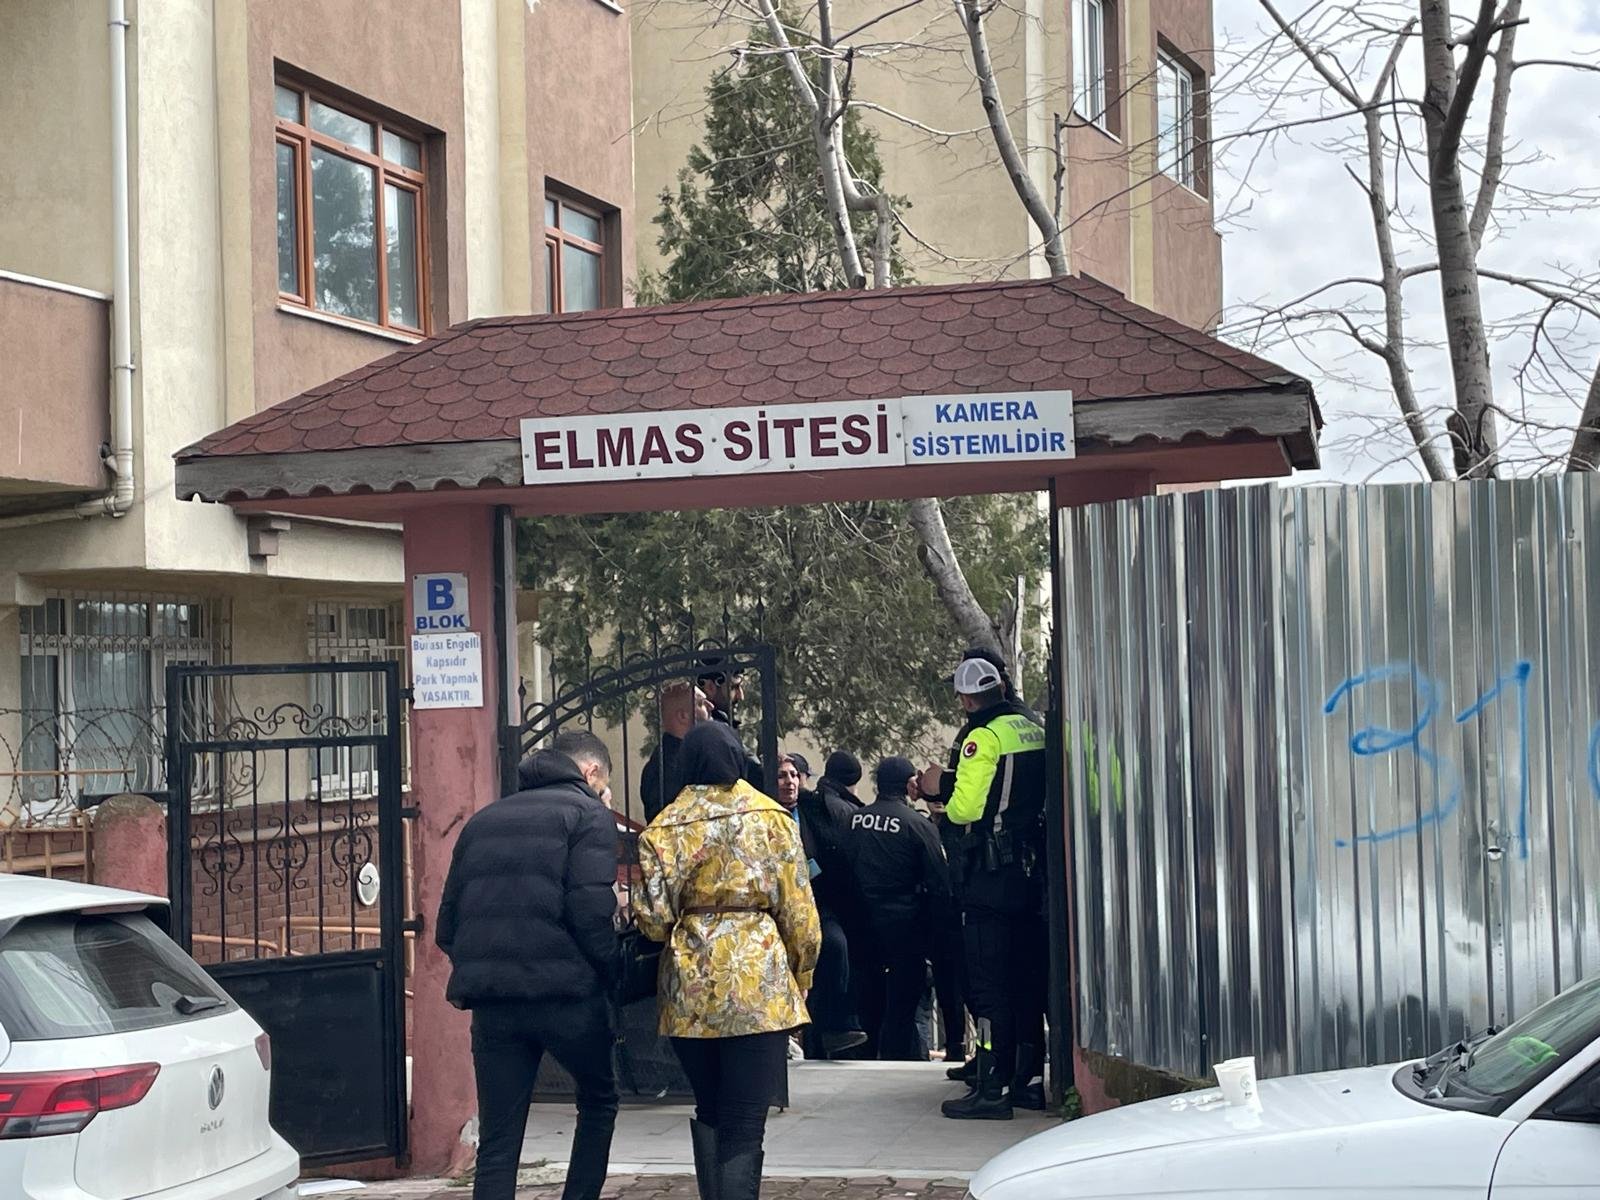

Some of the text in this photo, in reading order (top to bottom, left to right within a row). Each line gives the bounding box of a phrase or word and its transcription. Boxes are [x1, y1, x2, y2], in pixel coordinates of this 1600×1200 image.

[935, 400, 1038, 423] KAMERA
[534, 404, 888, 470] ELMAS SİTESİ
[912, 427, 1065, 457] SİSTEMLİDİR
[427, 578, 454, 611] B
[416, 614, 466, 629] BLOK
[413, 637, 479, 652] Burası Engelli
[426, 656, 466, 670] Kapsıdır
[415, 673, 478, 687] Park Yapmak
